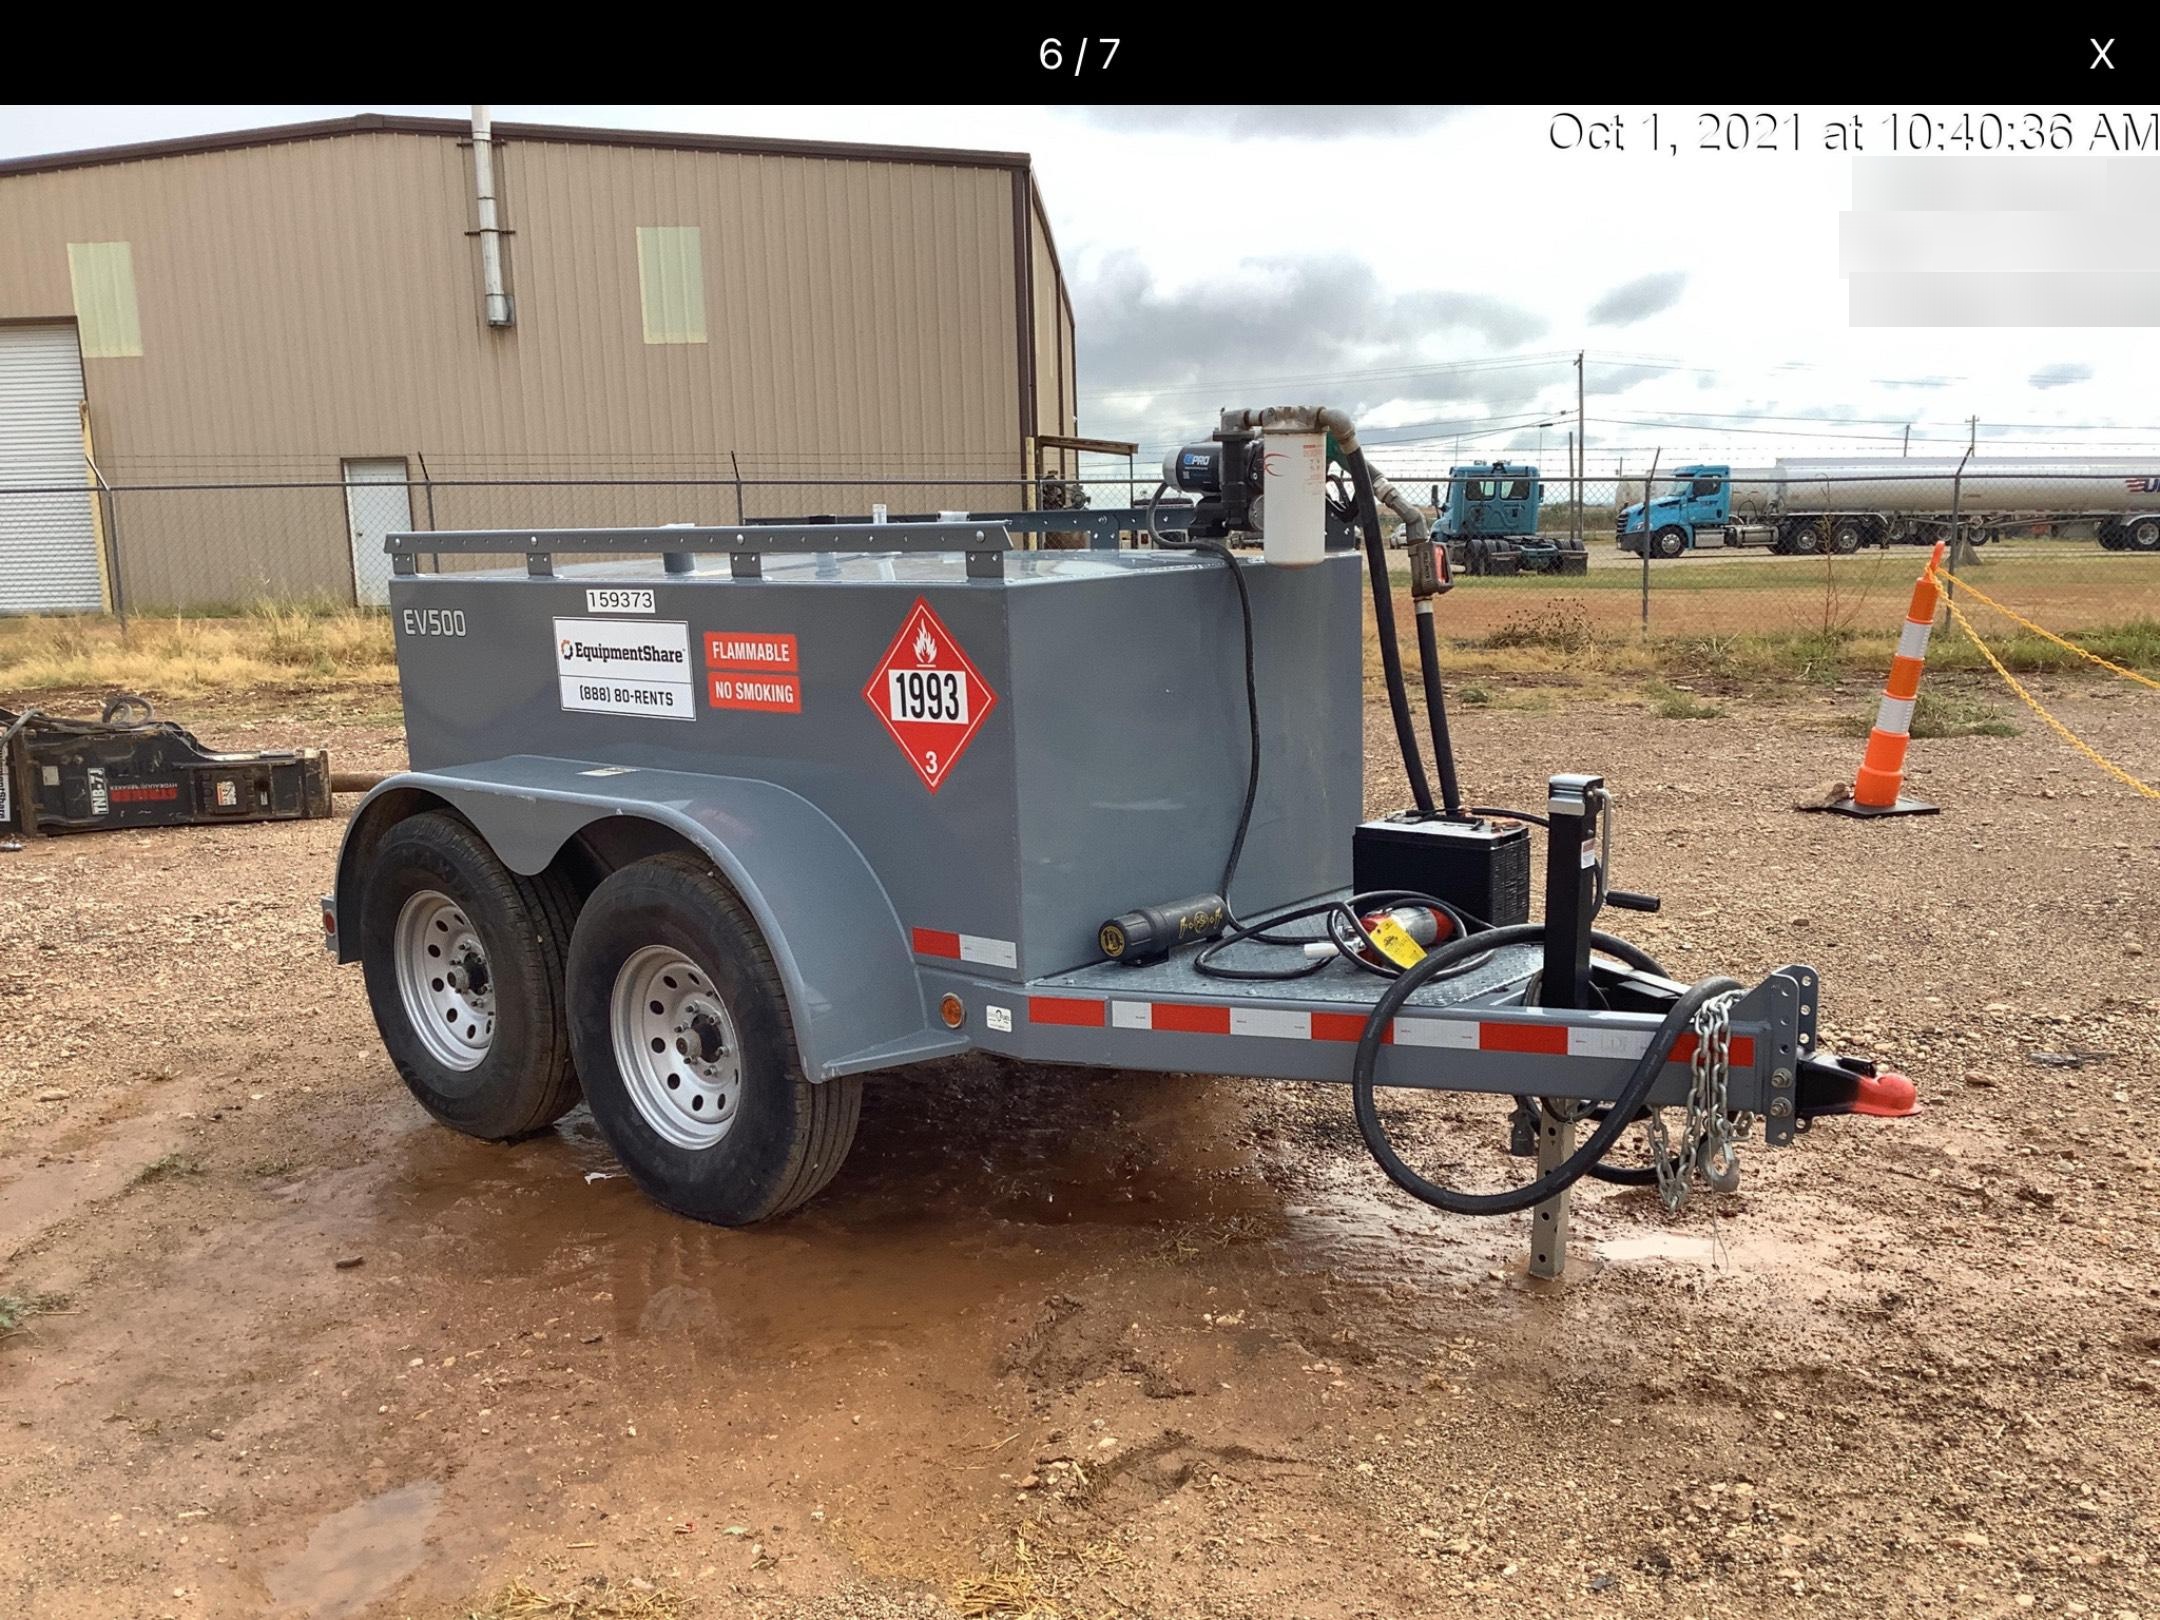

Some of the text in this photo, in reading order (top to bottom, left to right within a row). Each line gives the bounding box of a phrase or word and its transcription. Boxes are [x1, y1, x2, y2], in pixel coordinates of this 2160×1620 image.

[588, 591, 653, 609] 159373
[403, 608, 467, 637] EV500
[574, 642, 684, 663] EquipmentShare
[712, 641, 790, 662] FLAMMABLE
[579, 684, 611, 703] (888)
[715, 681, 794, 704] NO SMOKING
[896, 672, 960, 720] 1993
[925, 750, 938, 774] 3
